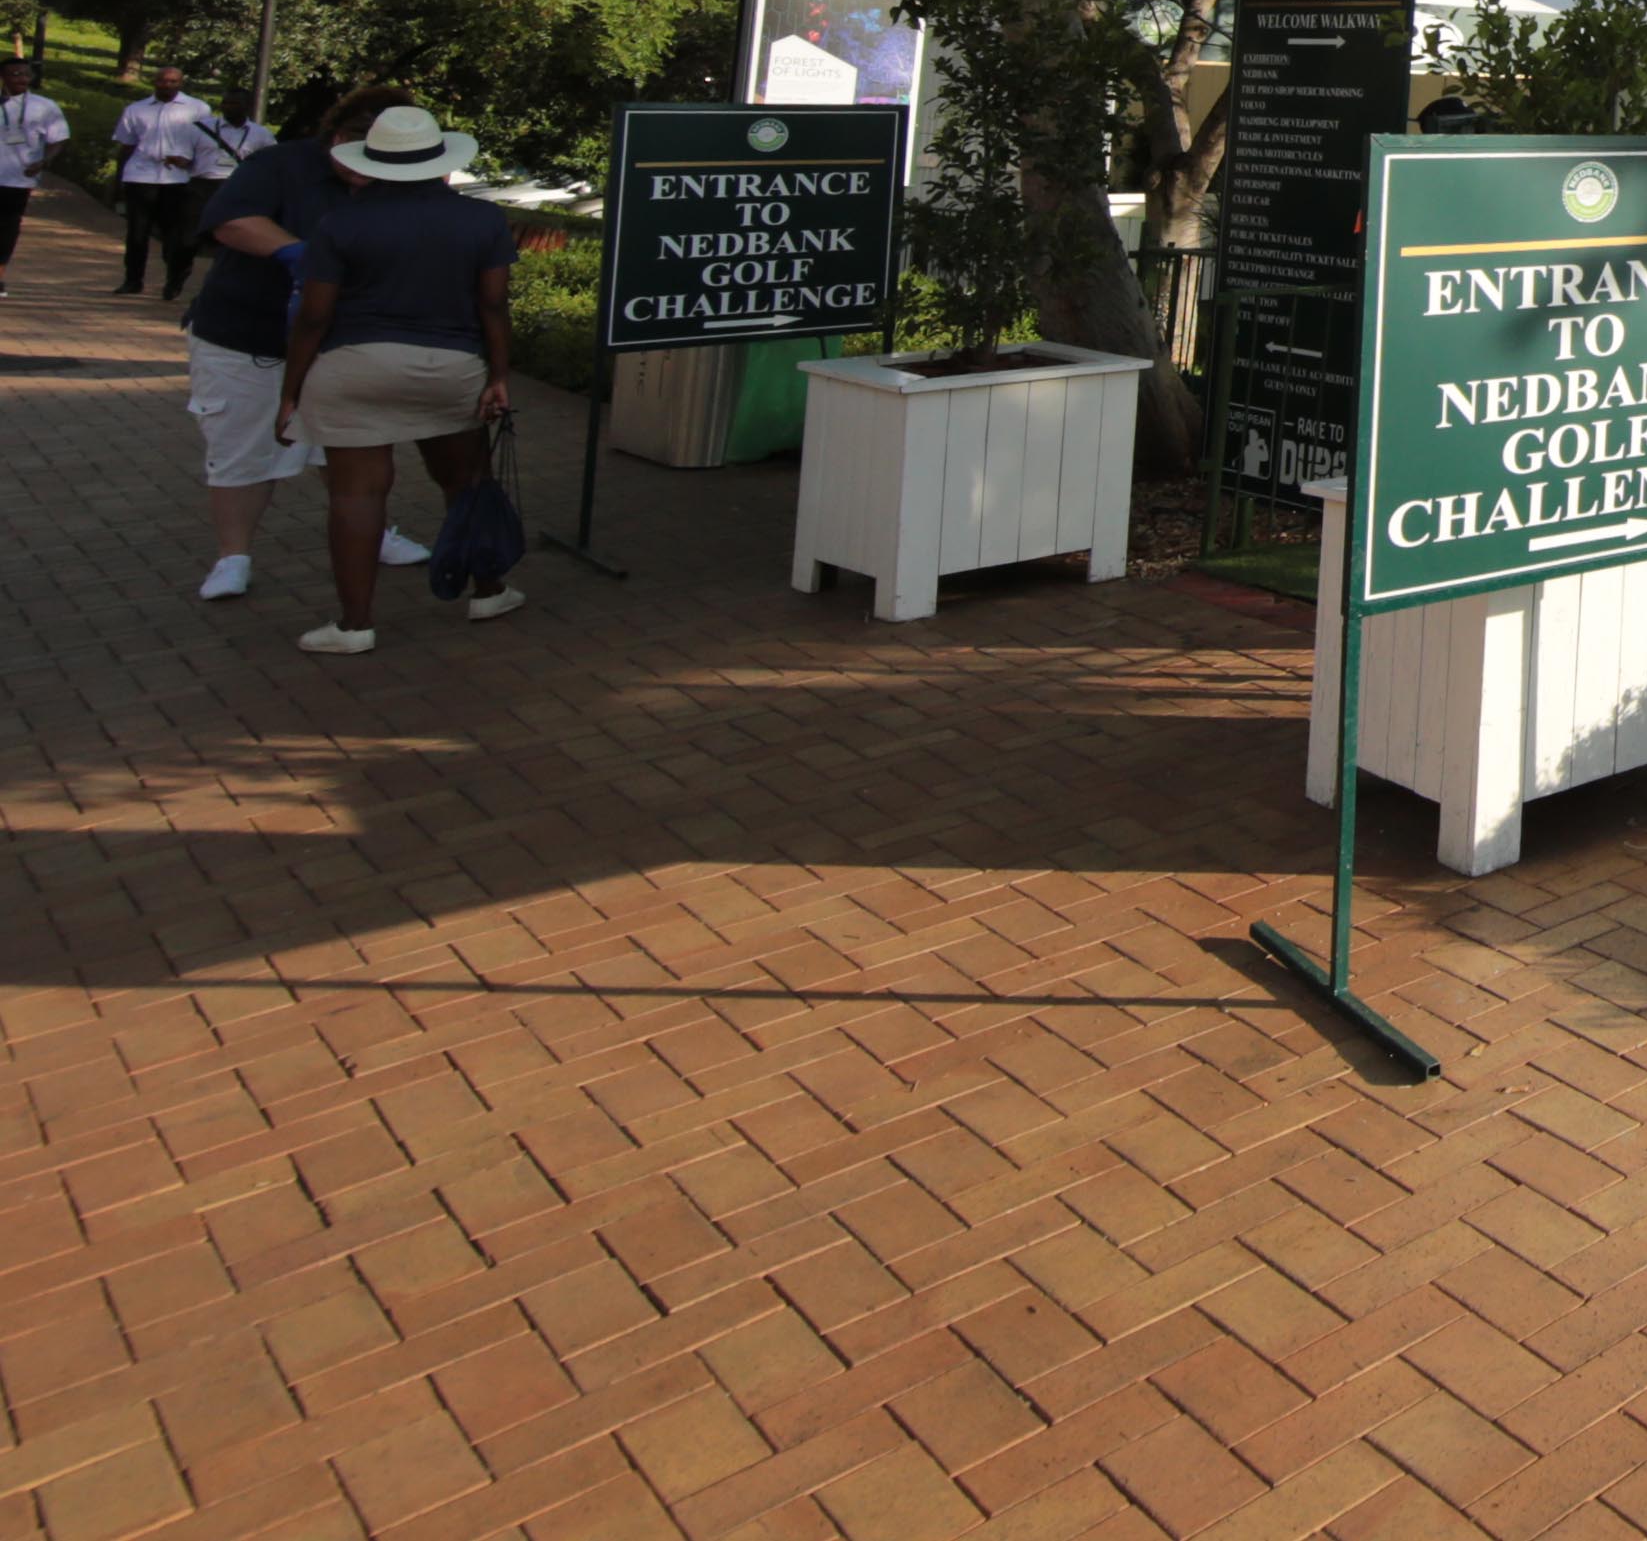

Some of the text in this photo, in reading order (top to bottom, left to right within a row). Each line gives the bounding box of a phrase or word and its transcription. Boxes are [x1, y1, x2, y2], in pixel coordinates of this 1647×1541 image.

[1257, 14, 1318, 29] WELCOME
[772, 66, 843, 79] OF LIGHTS
[774, 56, 825, 68] FOREST
[649, 171, 871, 200] ENTRANCE
[1315, 168, 1362, 181] MARKETIN
[735, 202, 790, 227] TO
[656, 227, 856, 260] NEDBANK
[701, 258, 814, 287] GOLF
[624, 283, 877, 322] CHALLENGE
[1548, 314, 1626, 361] TO
[1329, 423, 1345, 443] TO
